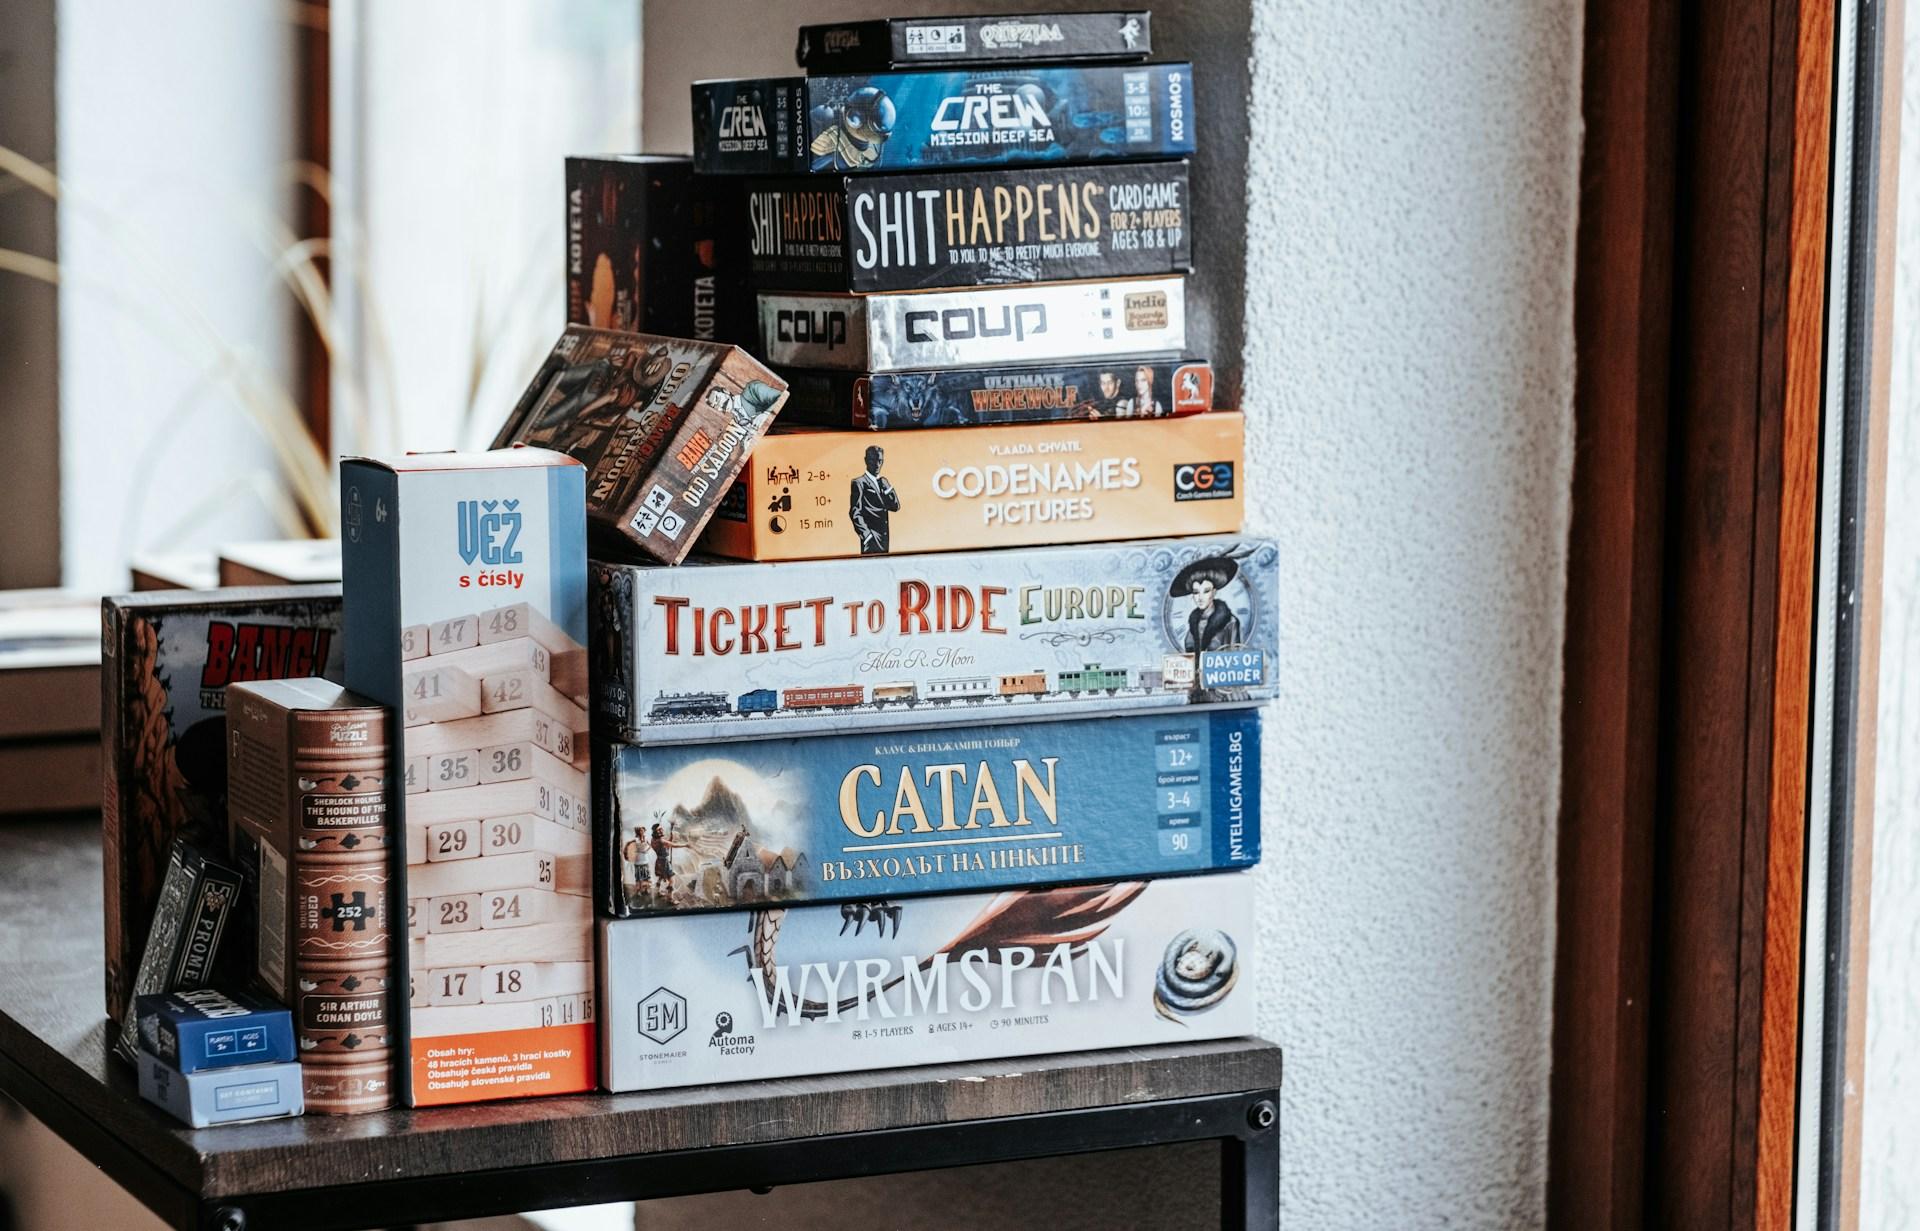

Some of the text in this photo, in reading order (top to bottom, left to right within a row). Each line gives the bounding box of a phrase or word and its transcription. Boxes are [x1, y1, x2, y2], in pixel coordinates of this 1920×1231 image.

[976, 84, 1002, 94] THE
[931, 94, 1051, 130] CREW
[1168, 72, 1184, 141] KOSMOS
[719, 105, 767, 137] CREW
[796, 88, 804, 157] KOSMOS
[757, 139, 768, 151] SEA
[931, 129, 1055, 146] MISSION DEEP SEA
[1109, 182, 1180, 211] CARD GAME
[750, 192, 843, 256] SHIT HAPPENS
[854, 189, 941, 269] SHIT
[1110, 212, 1128, 230] FOR
[1142, 209, 1181, 229] PLAYERS
[1112, 227, 1182, 251] AGES 18 & UP
[949, 249, 958, 264] TO
[978, 247, 987, 262] TO
[1004, 246, 1014, 261] TO
[1015, 245, 1040, 260] PRETTY
[1043, 243, 1064, 258] MUCH
[1126, 296, 1166, 309] Indie
[984, 374, 1065, 389] ULTIMATE
[970, 386, 1078, 412] WEREWOLF
[592, 362, 690, 501] OLD SALOON
[676, 427, 713, 471] BANG!
[989, 443, 1034, 456] VLAADA
[682, 476, 710, 507] OLD
[699, 418, 748, 480] SALOON
[932, 457, 1141, 498] CODENAMES
[815, 497, 831, 506] 10+
[983, 499, 1093, 525] PICTURES
[800, 518, 833, 528] 15 min
[459, 569, 524, 589] s čísly
[439, 609, 517, 645] 47 48
[654, 579, 1145, 656] TICKET TO RIDE EUROPE
[201, 621, 331, 688] BANG!
[859, 647, 976, 674] Alan R. Moon
[1242, 653, 1260, 666] OF
[414, 646, 545, 702] 41 42 43
[200, 690, 226, 709] TH
[330, 730, 368, 741] PUZZLE
[535, 719, 571, 757] 37 38
[908, 744, 917, 753] &
[1170, 749, 1192, 767] 12+
[440, 748, 521, 781] 35 36
[314, 795, 381, 806] SHERLOCK HOLMES
[539, 786, 587, 826] 31 32 33
[838, 757, 1059, 838] CATAN
[1229, 732, 1243, 860] INTELLIGAMES.BG
[307, 803, 387, 815] THE HOUND OF THE
[317, 815, 380, 825] BASKERVILLES
[439, 822, 521, 853] 29 30
[1172, 833, 1188, 850] 90
[539, 859, 551, 883] 25
[822, 844, 1085, 881] ВЪЗХОДЪТ НА ИНКИТЕ
[308, 895, 319, 929] SIDED
[337, 906, 362, 919] 252
[440, 895, 521, 924] 23 24
[187, 919, 214, 985] PROME
[442, 973, 467, 997] 17
[495, 969, 522, 993] 18
[750, 938, 1125, 1030] WYRMSPAN
[316, 1010, 382, 1023] CONAN DOYLE
[320, 999, 379, 1011] SIR ARTHUR
[541, 1000, 592, 1027] 13 14 15
[647, 1001, 678, 1032] SM
[880, 1025, 914, 1037] PLAYERS
[936, 1021, 973, 1032] AGES 14+
[1001, 1015, 1049, 1027] 90 MINUTES
[427, 1047, 475, 1058] Obsah hry:
[709, 1035, 755, 1048] Automa
[720, 1046, 755, 1056] Factory
[513, 1053, 518, 1061] 3
[543, 1049, 572, 1060] kostky
[639, 1051, 687, 1061] STONEMAIER
[428, 1068, 469, 1080] Obsahuje
[498, 1062, 532, 1074] pravidla
[428, 1079, 469, 1090] Obsahuje
[471, 1075, 515, 1086] slovenské
